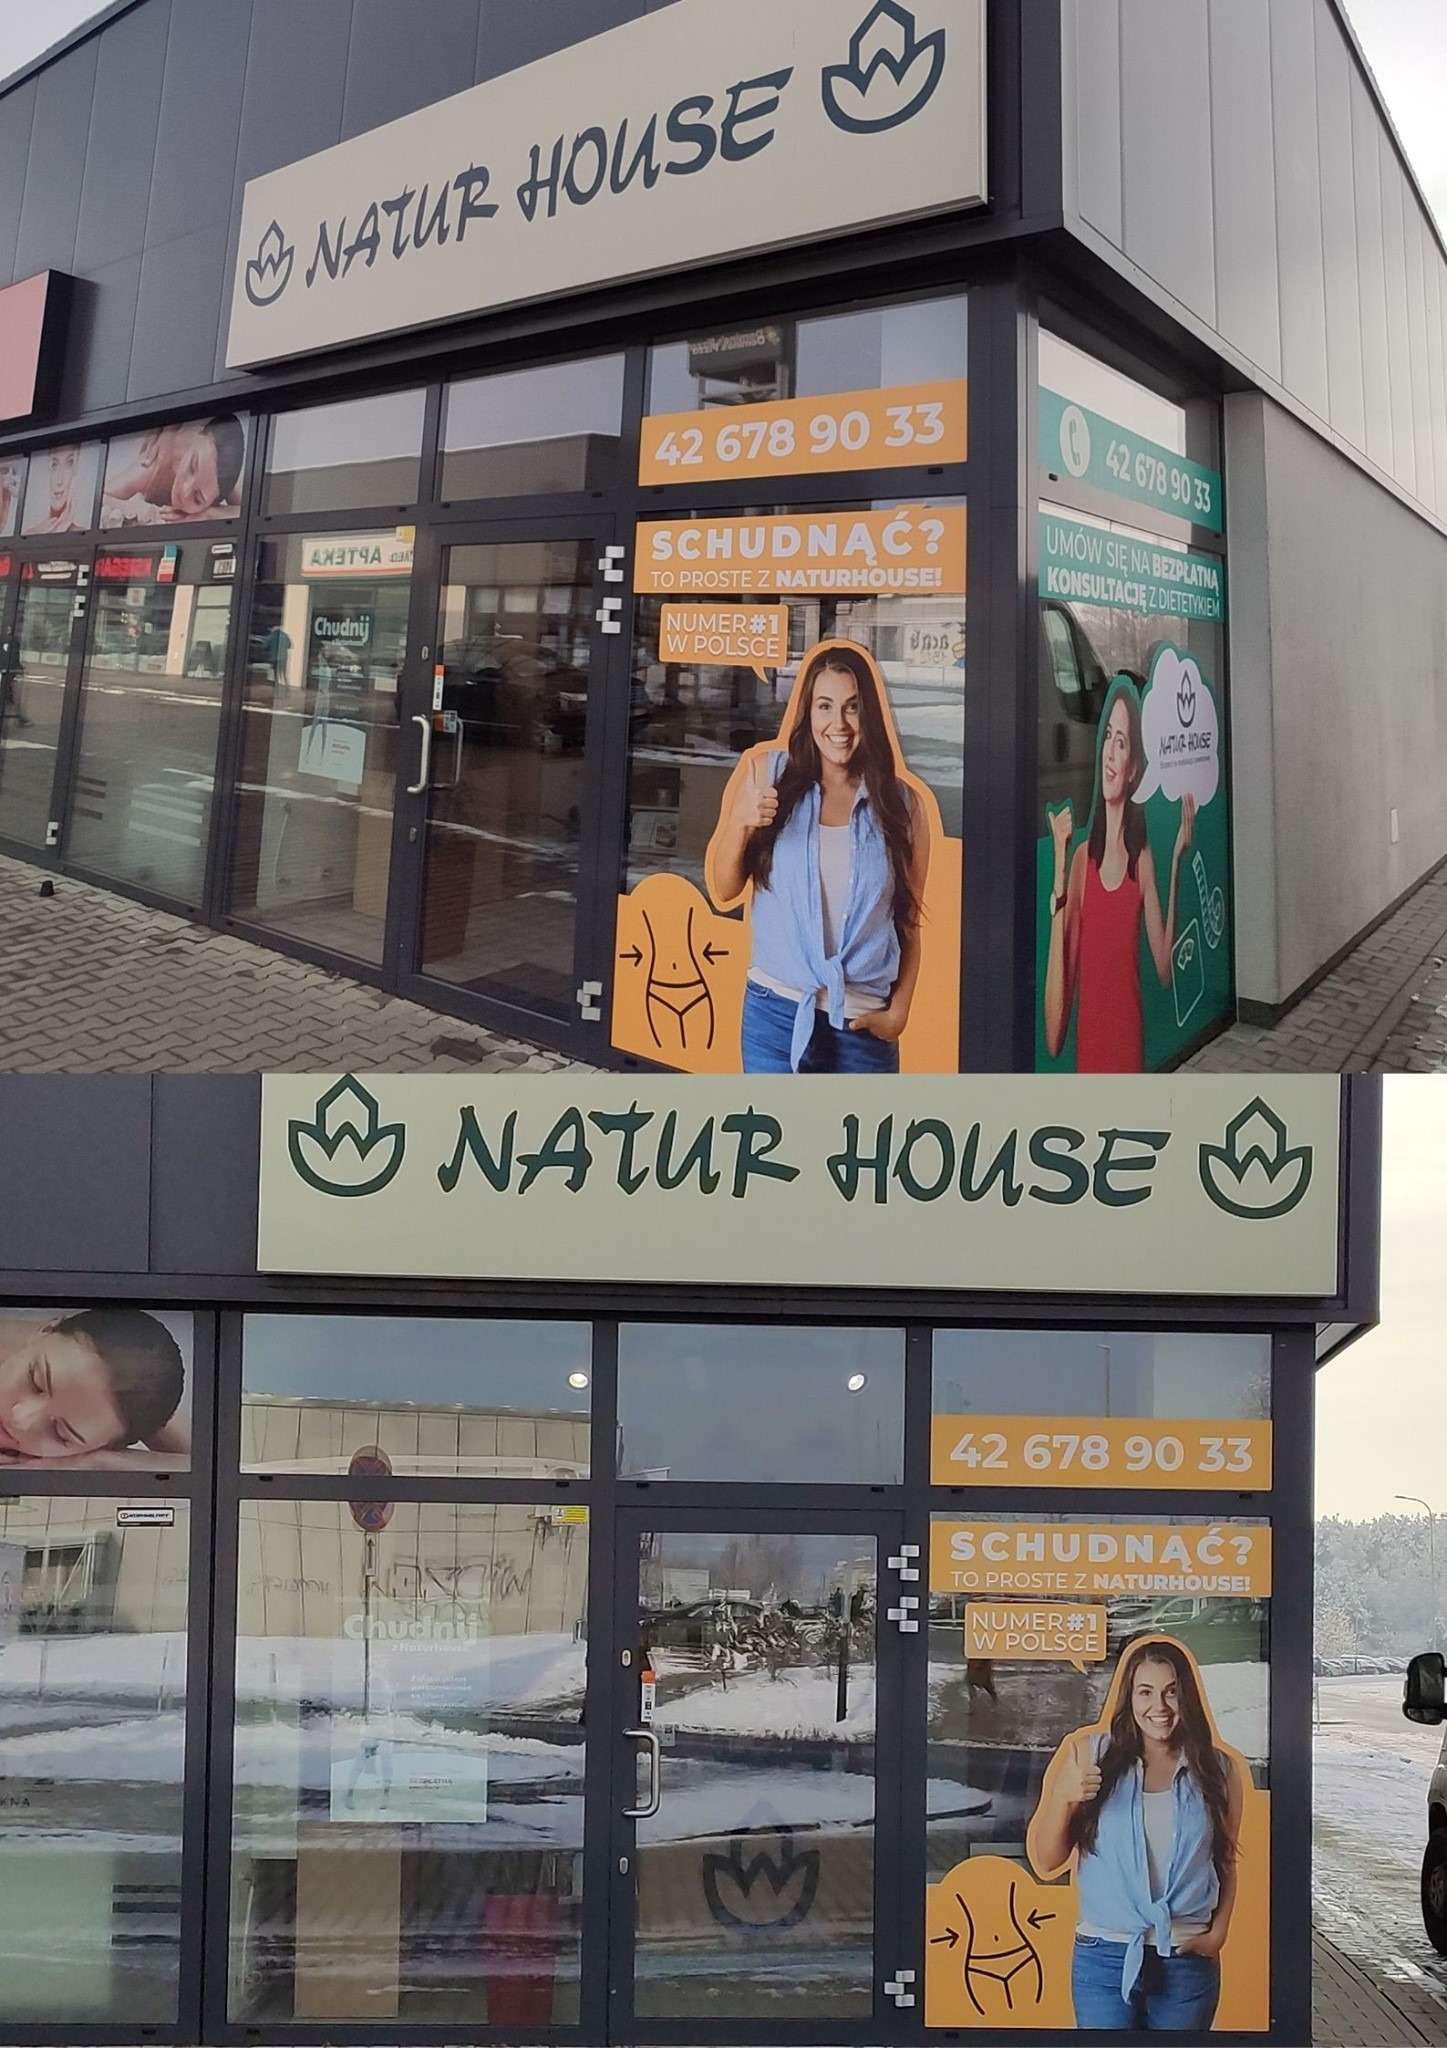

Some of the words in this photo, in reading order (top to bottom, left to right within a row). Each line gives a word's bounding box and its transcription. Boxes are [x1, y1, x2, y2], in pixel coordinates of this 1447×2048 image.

[305, 161, 499, 288] NATUR
[517, 67, 794, 222] HOUSE
[654, 429, 704, 466] 42
[715, 419, 796, 462] 678
[809, 411, 870, 454] 90
[884, 402, 945, 447] 33
[1105, 440, 1131, 482] 42
[1135, 452, 1168, 496] 678
[1171, 468, 1191, 505] 90
[1194, 478, 1211, 513] 33
[651, 511, 945, 566] SCHUDNĄĆ?
[651, 571, 675, 588] TO
[679, 570, 753, 588] PROSTE
[758, 570, 770, 588] Z
[776, 568, 942, 588] NATURHOUSE!
[1046, 525, 1102, 565] UMÓW
[1106, 542, 1128, 577] SIĘ
[1131, 553, 1150, 575] NA
[1152, 553, 1219, 597] BEZPŁATNĄ
[1047, 566, 1148, 613] KONSULTACJĘ
[1149, 587, 1157, 608] Z
[1159, 587, 1220, 618] DIETETYKIEM
[314, 615, 370, 643] Chudnij
[666, 612, 747, 634] NUMER
[667, 635, 687, 654] W
[694, 636, 780, 659] POLSCE
[1159, 734, 1186, 755] NATUR
[1188, 732, 1212, 752] HOUSE
[438, 1101, 800, 1197] NATUR
[826, 1112, 1172, 1207] HOUSE
[950, 1433, 1008, 1468] 42
[1023, 1434, 1109, 1470] 678
[1124, 1436, 1184, 1471] 90
[1198, 1437, 1253, 1472] 33
[950, 1528, 1253, 1573] SCHUDNĄĆ?
[950, 1571, 979, 1588] TO
[985, 1571, 1068, 1590] PROSTE
[1074, 1572, 1087, 1590] Z
[1093, 1573, 1251, 1592] NATURHOUSE!
[344, 1612, 478, 1646] Chudnij
[971, 1610, 1063, 1632] NUMER
[973, 1631, 998, 1650] W
[1005, 1631, 1099, 1653] POLSCE
